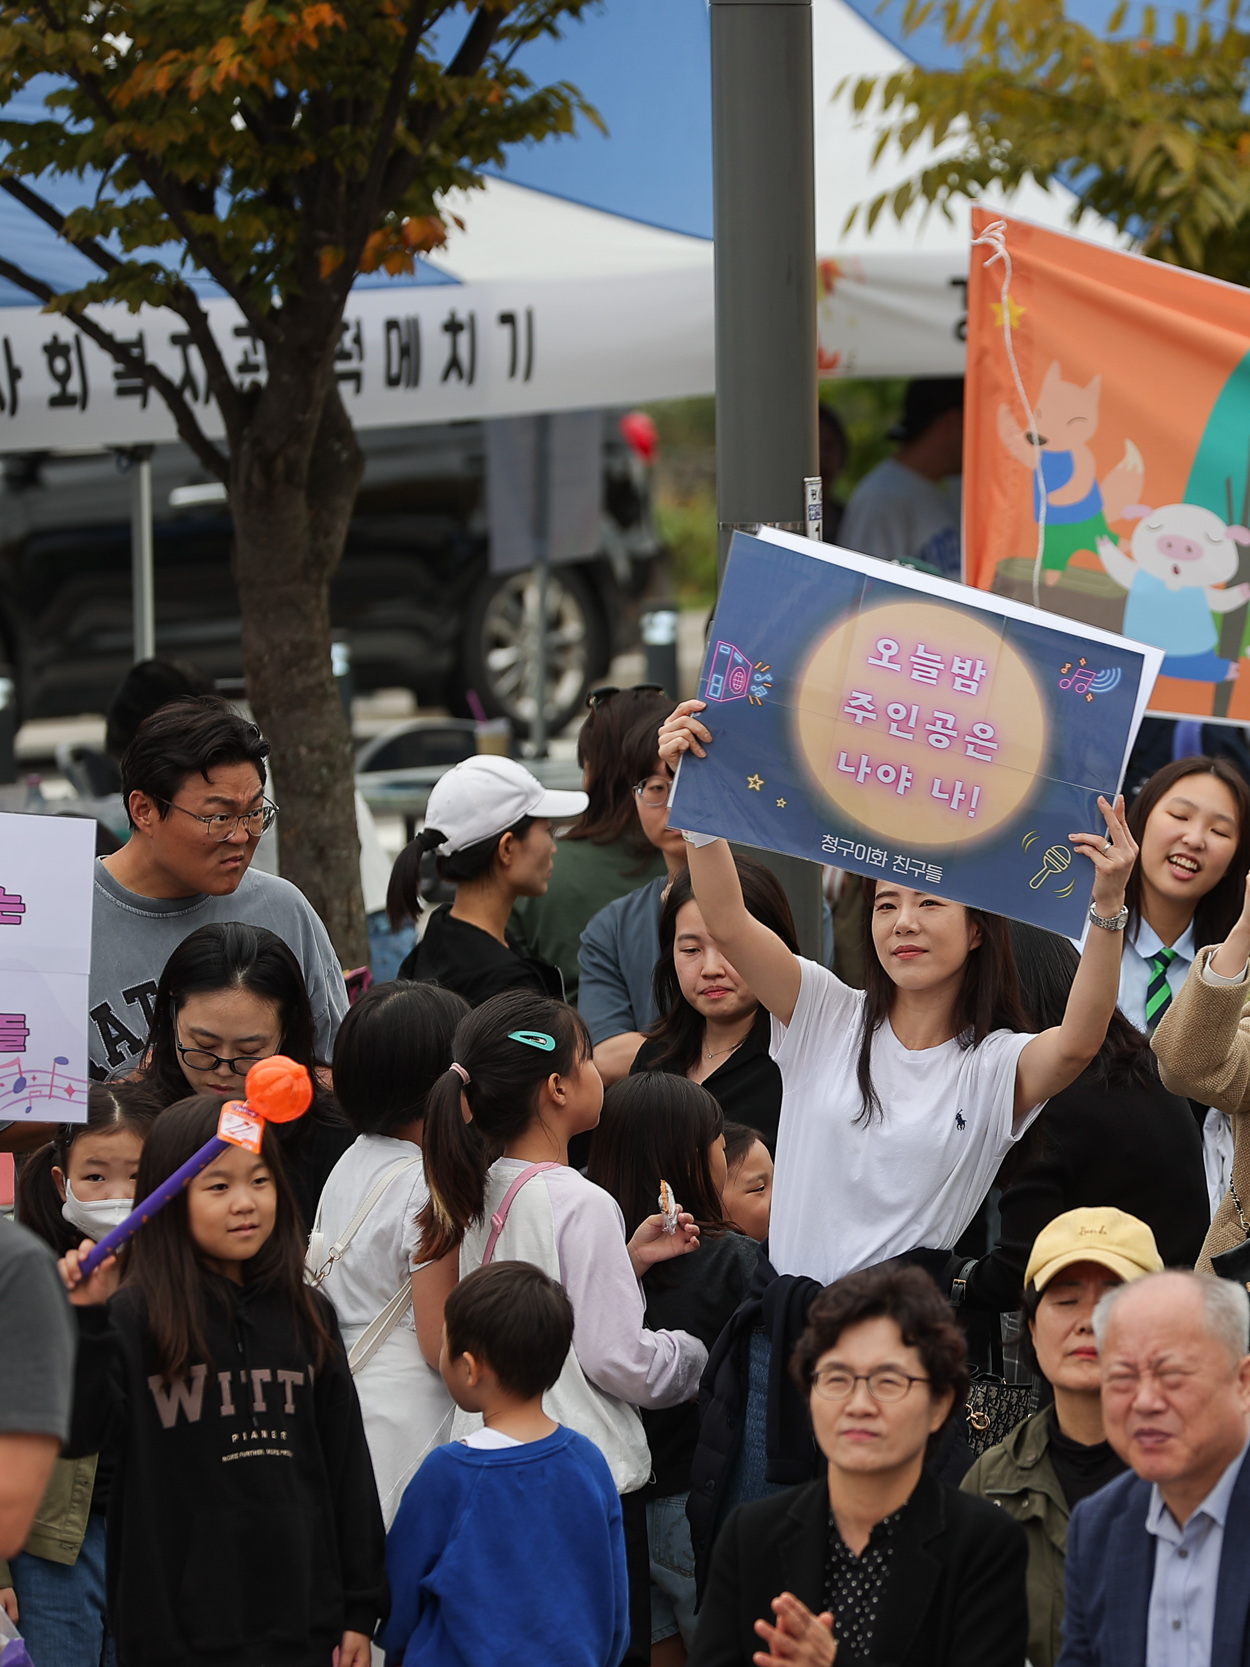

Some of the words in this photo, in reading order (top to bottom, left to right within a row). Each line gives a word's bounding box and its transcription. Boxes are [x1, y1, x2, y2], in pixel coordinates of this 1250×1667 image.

[866, 638, 988, 695] 오늘밤
[843, 690, 999, 763] 주인공은
[836, 751, 914, 796] 나야
[930, 778, 981, 818] 나!
[821, 833, 889, 869] 청구이화
[892, 854, 943, 884] 친구들
[147, 1363, 316, 1429] WITT
